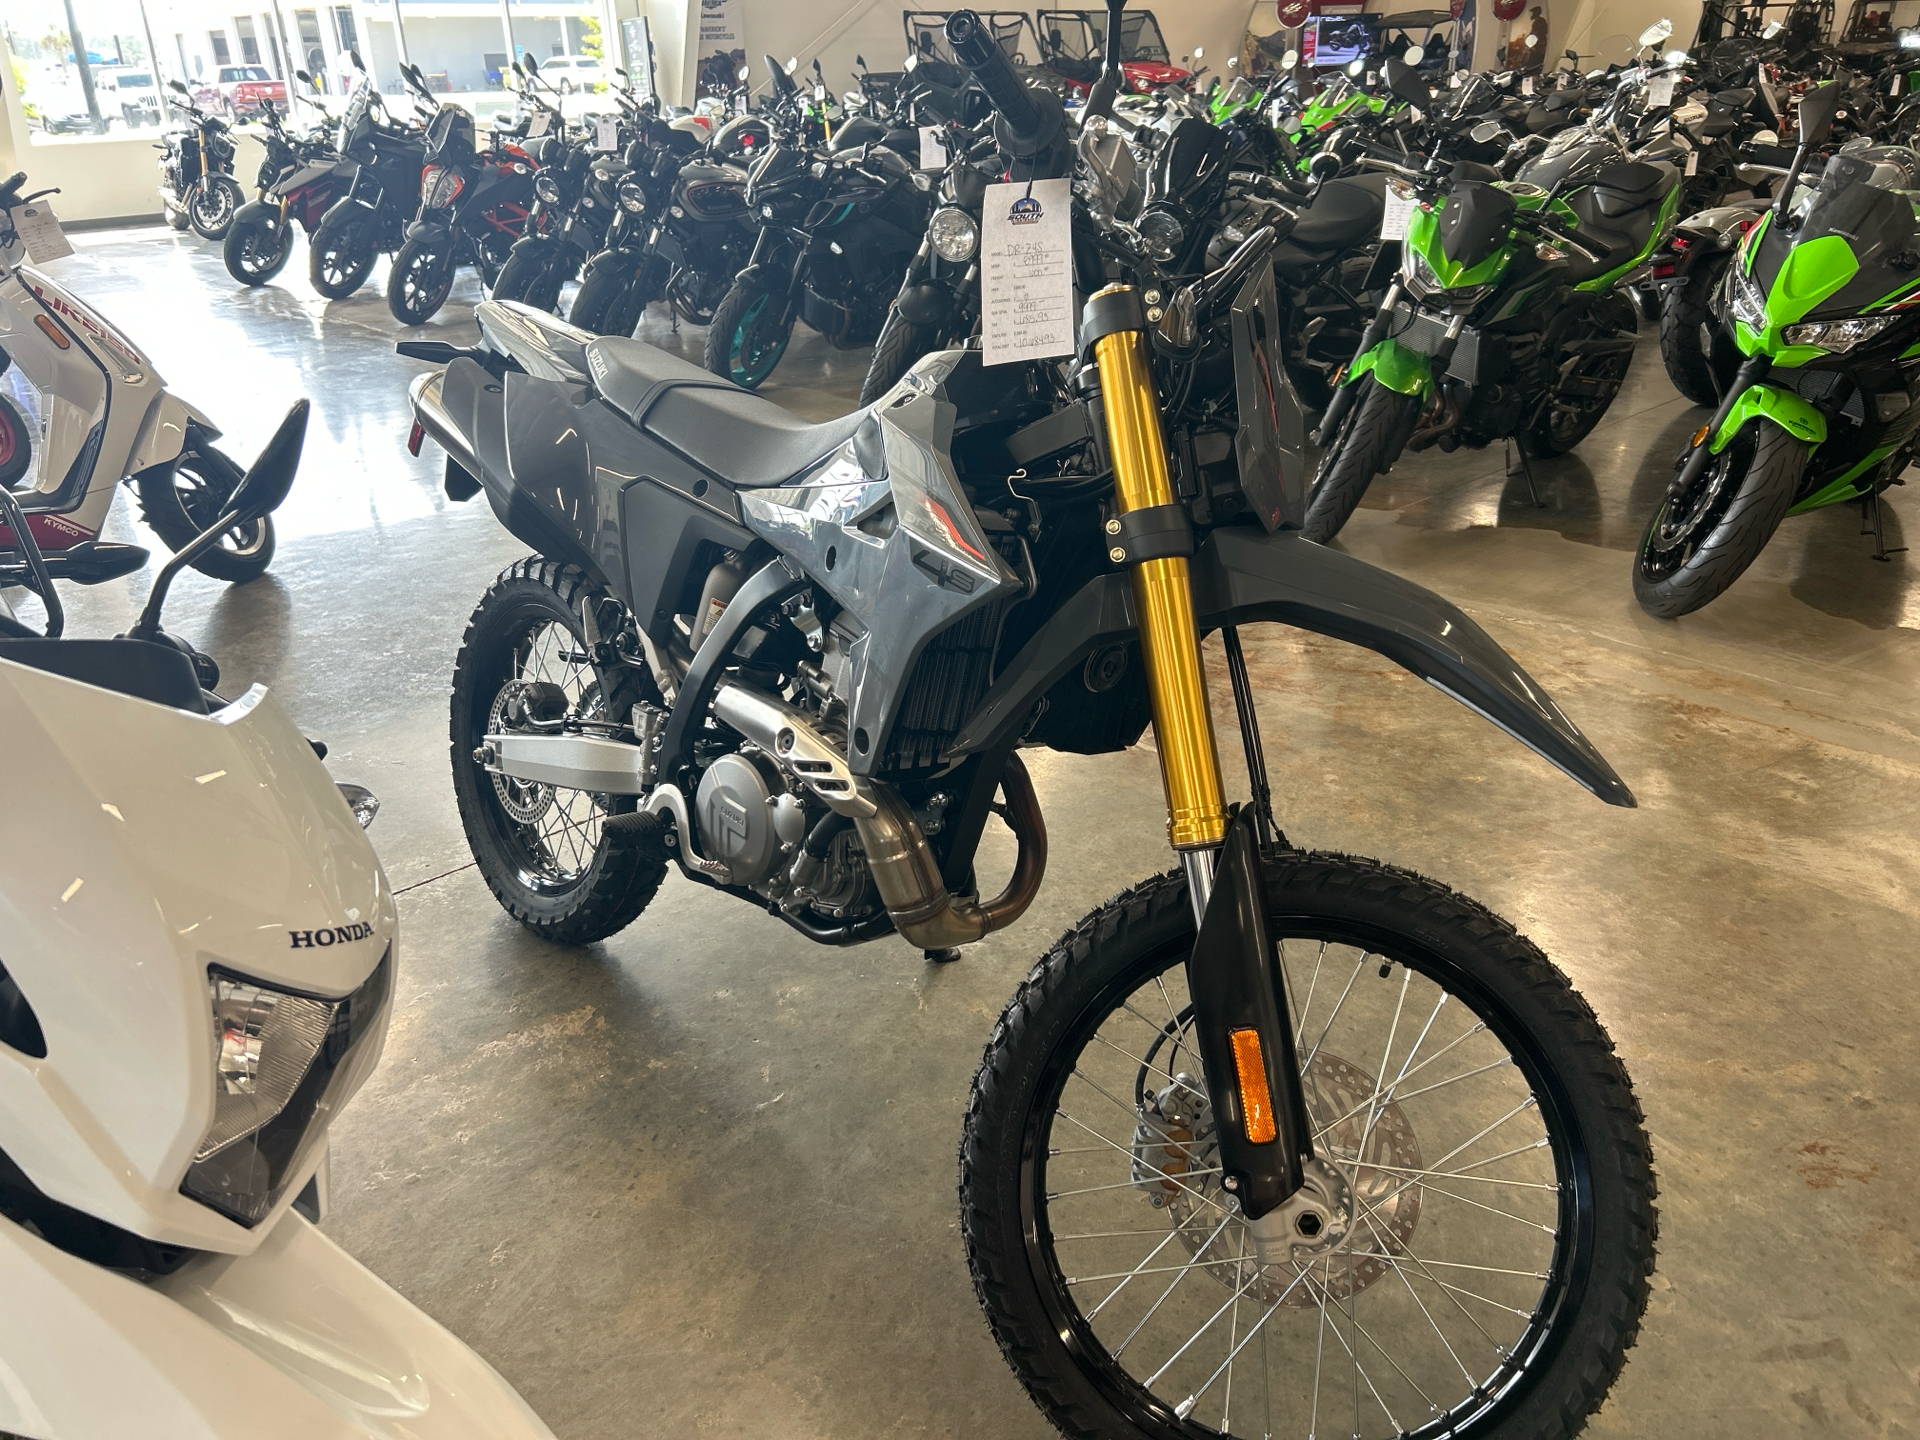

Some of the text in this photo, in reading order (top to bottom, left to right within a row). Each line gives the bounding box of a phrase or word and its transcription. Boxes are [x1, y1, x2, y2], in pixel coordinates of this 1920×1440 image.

[1007, 212, 1045, 221] SOUTH
[589, 347, 608, 380] SUZUKI
[43, 517, 79, 537] KYMCO
[720, 805, 745, 827] SUZUKI
[288, 920, 375, 949] HONDA
